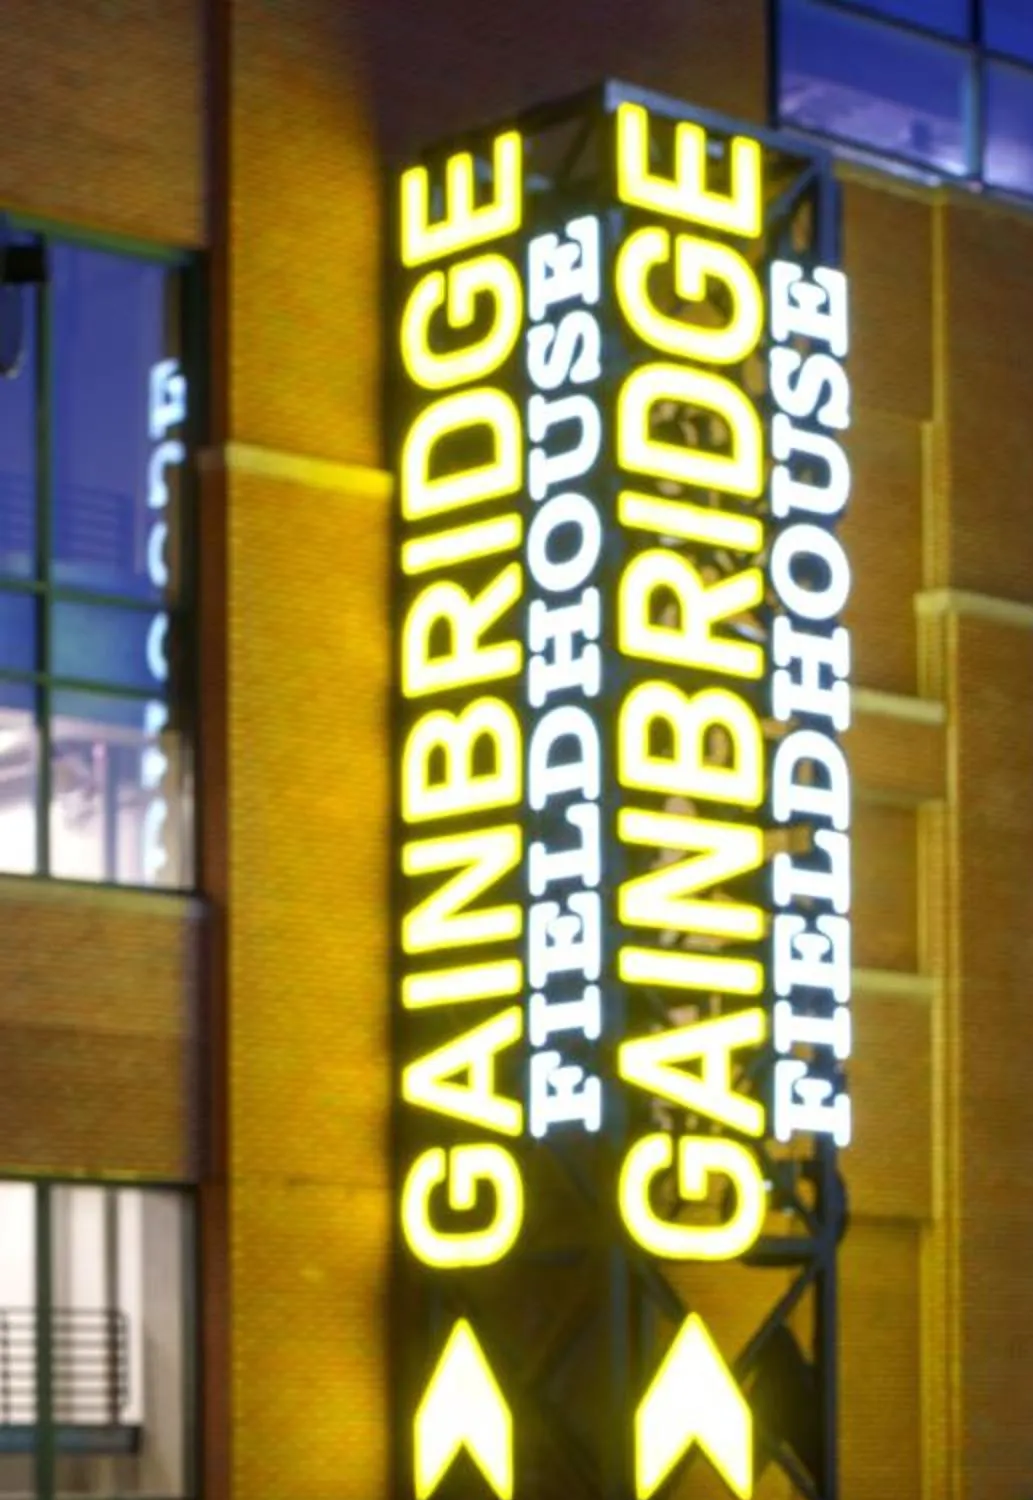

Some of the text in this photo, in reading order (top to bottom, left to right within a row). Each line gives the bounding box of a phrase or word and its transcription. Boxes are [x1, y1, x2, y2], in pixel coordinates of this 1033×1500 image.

[401, 131, 524, 1268] GAINBRIDGE
[527, 215, 601, 1138] FIELDHOUSE
[615, 101, 767, 1260] GAINBRIDGE
[769, 260, 852, 1147] FIELDHOUSE
